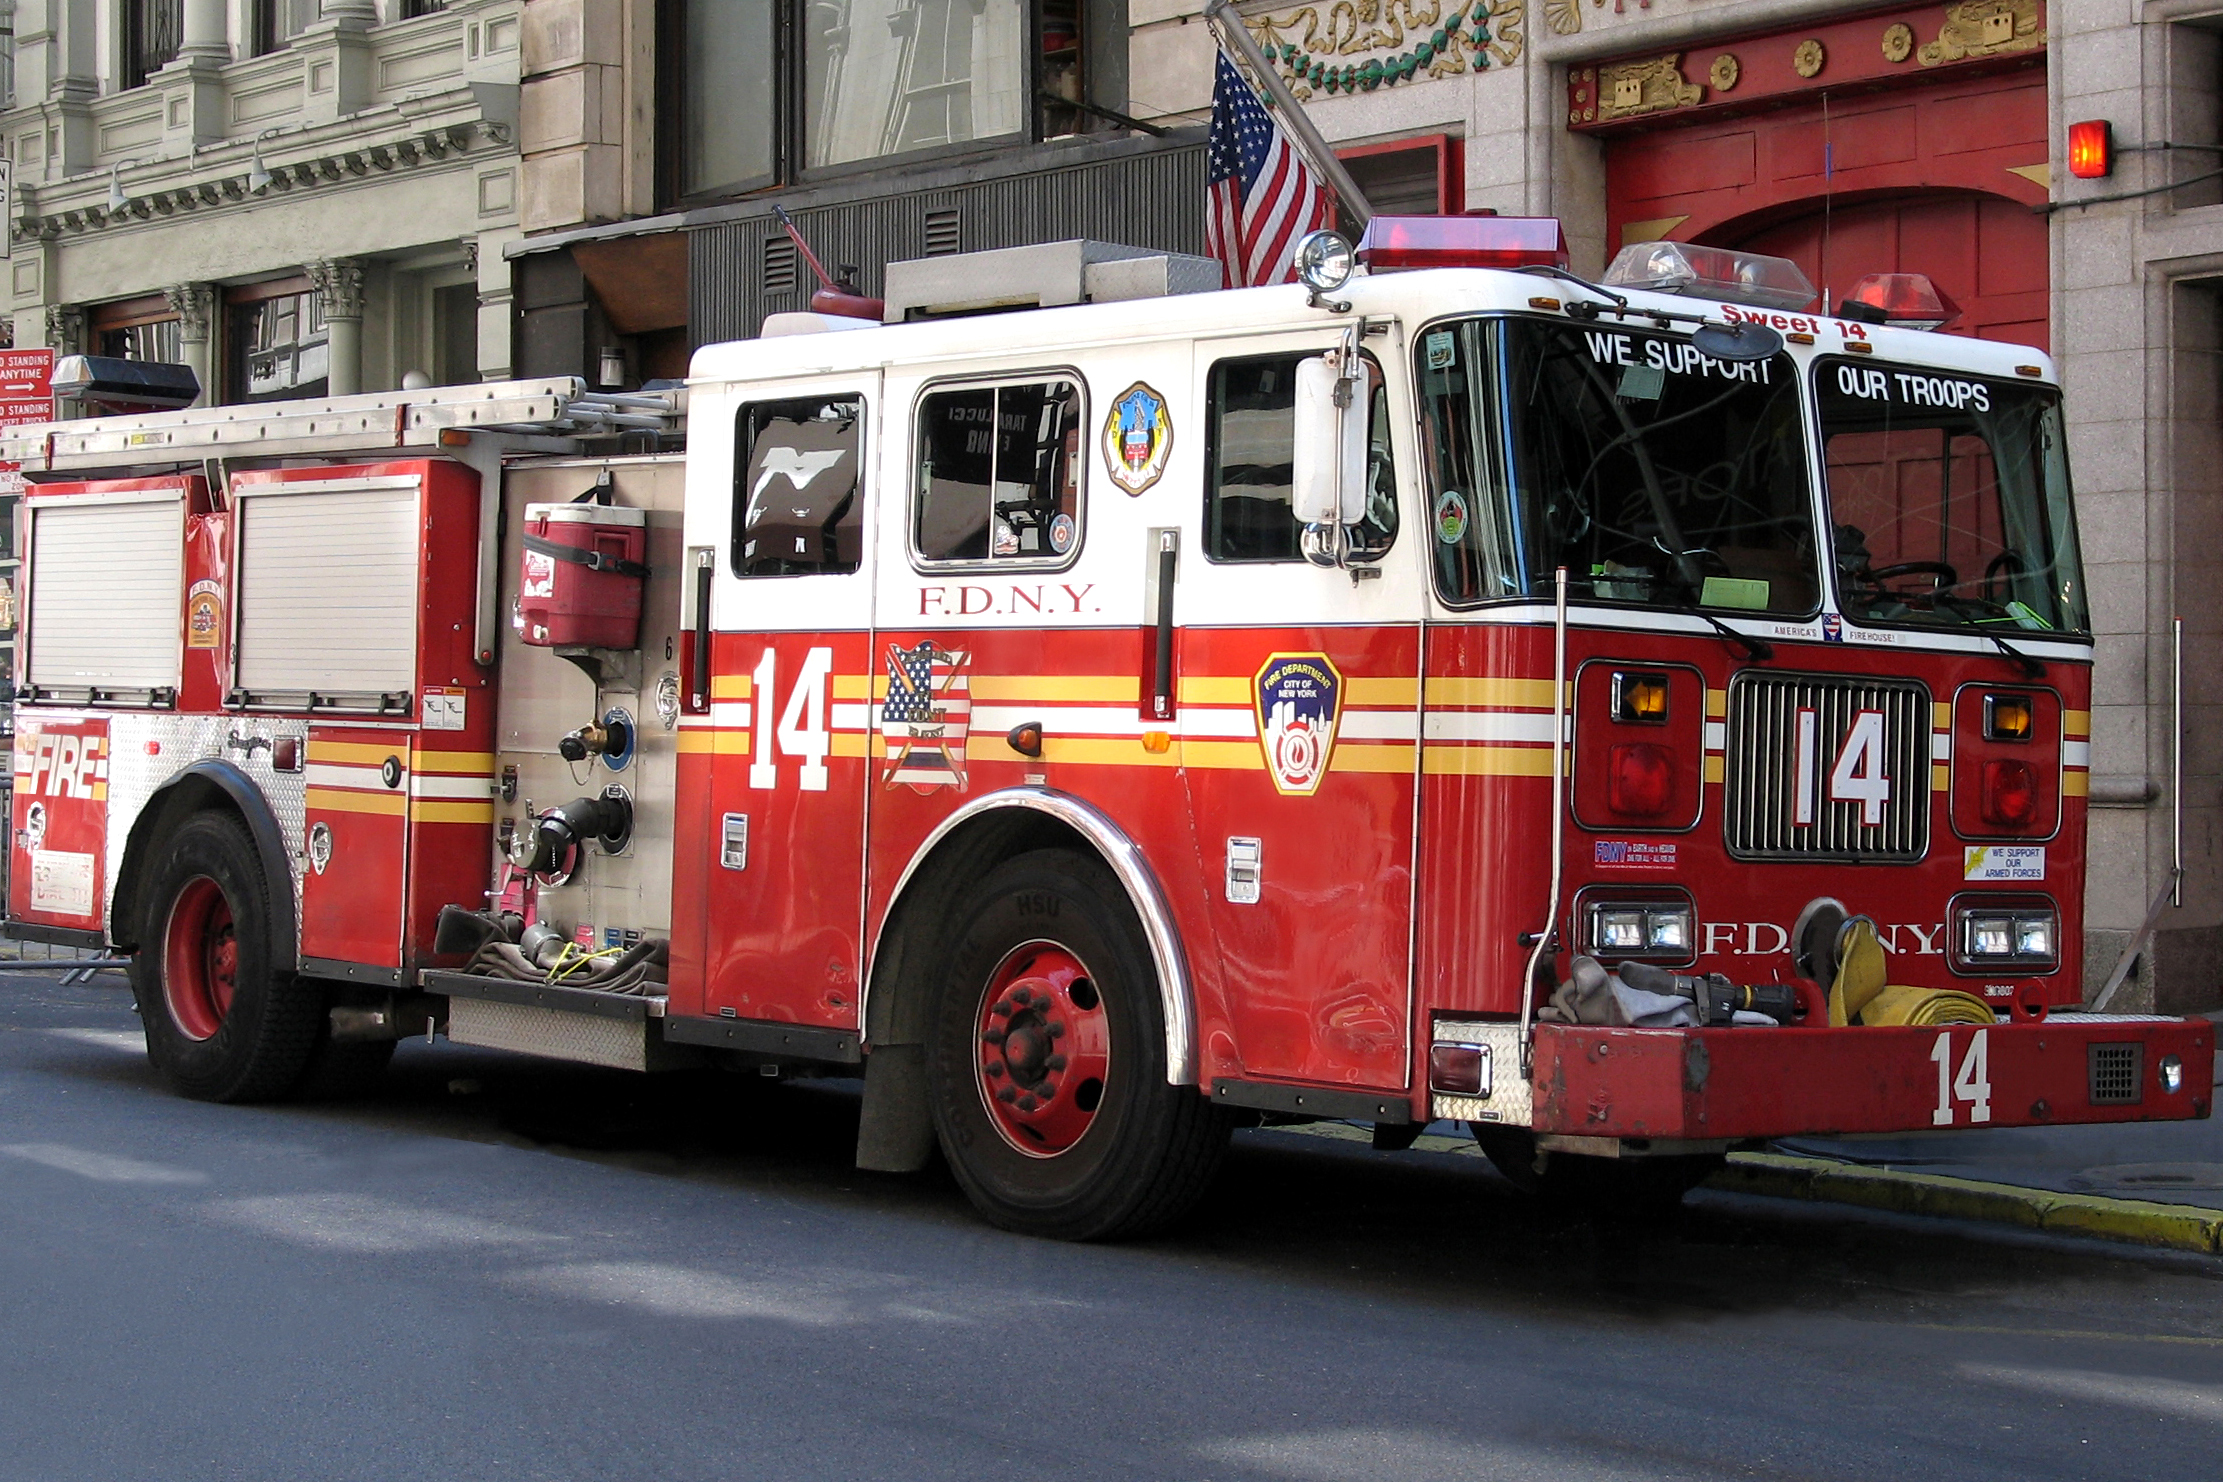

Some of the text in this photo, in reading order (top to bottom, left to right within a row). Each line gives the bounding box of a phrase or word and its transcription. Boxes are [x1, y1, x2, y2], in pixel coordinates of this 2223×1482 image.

[1720, 304, 1868, 340] Sweet 14
[8, 354, 50, 367] STANDING
[1584, 332, 1773, 385] WE SUPPORT
[0, 368, 43, 380] ANYTIME
[1837, 365, 1990, 413] OUR TROOPS
[8, 403, 50, 416] STANDING
[918, 583, 1102, 615] F.D.N.Y.
[665, 636, 673, 661] 6
[1278, 689, 1318, 699] NEW YORK
[1283, 679, 1313, 689] CITY OF
[749, 647, 832, 791] 14
[29, 733, 101, 799] FIRE
[1792, 707, 1891, 829] 14
[1594, 841, 1628, 863] FDNY
[1992, 848, 2040, 857] WE SUPPORT
[2005, 858, 2022, 868] OUR
[1985, 868, 2042, 878] ARMED FORCES
[1930, 1028, 1991, 1125] 14
